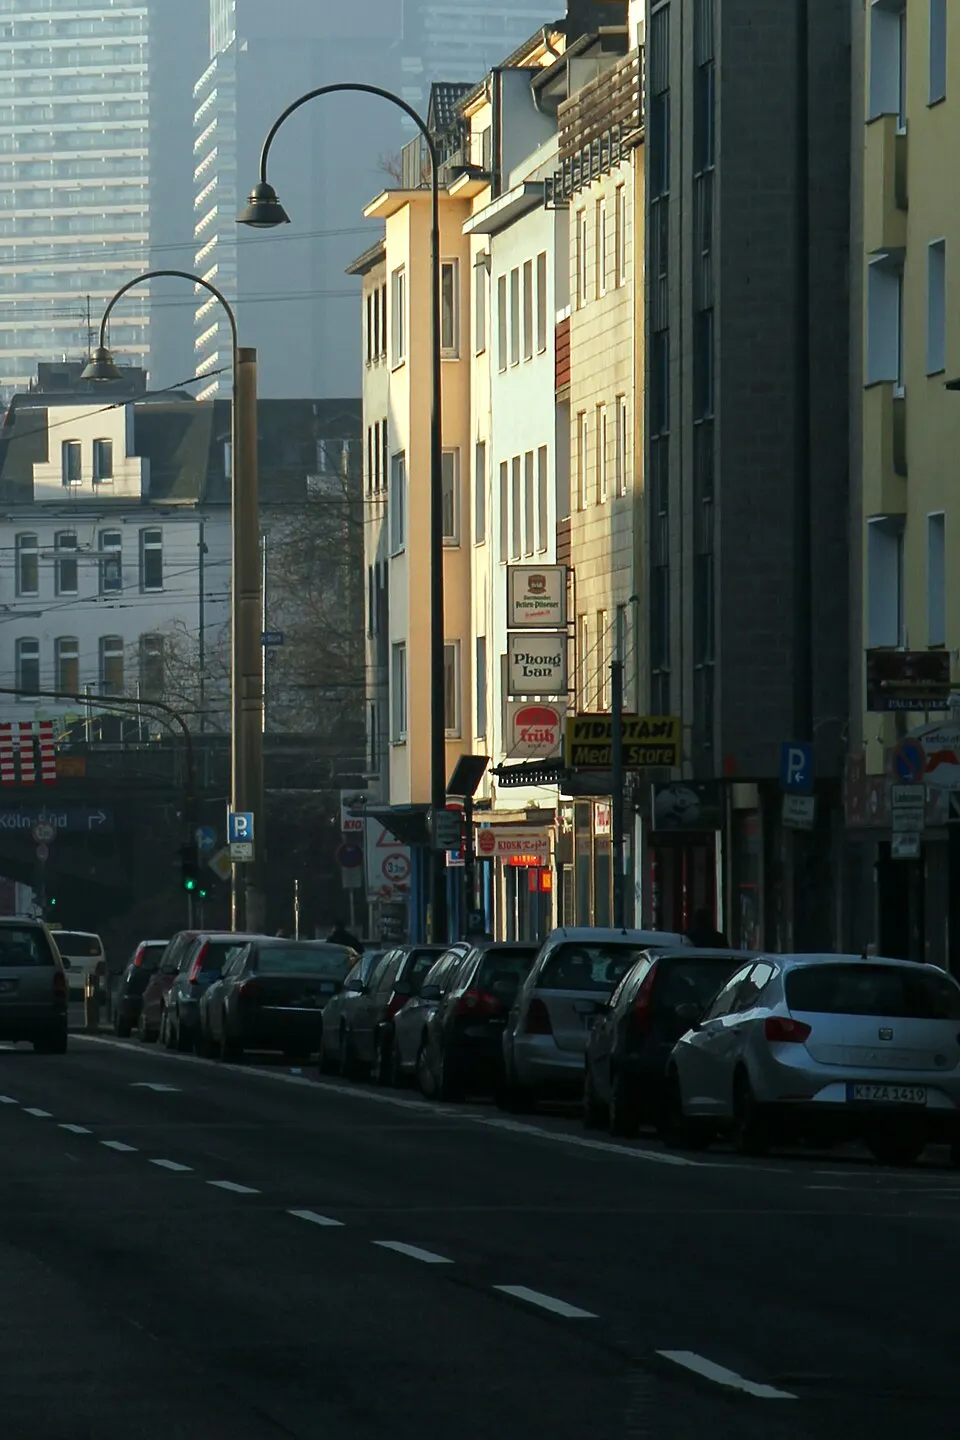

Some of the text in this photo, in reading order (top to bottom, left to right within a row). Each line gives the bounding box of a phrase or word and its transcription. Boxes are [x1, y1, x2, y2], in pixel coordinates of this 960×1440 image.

[514, 653, 561, 667] Phong
[522, 666, 552, 677] Lan
[520, 728, 554, 744] früh
[573, 746, 613, 764] Medi
[628, 746, 673, 763] Store
[787, 748, 805, 784] P
[235, 816, 247, 837] P
[344, 820, 362, 830] KIO
[498, 840, 521, 850] KIOSK
